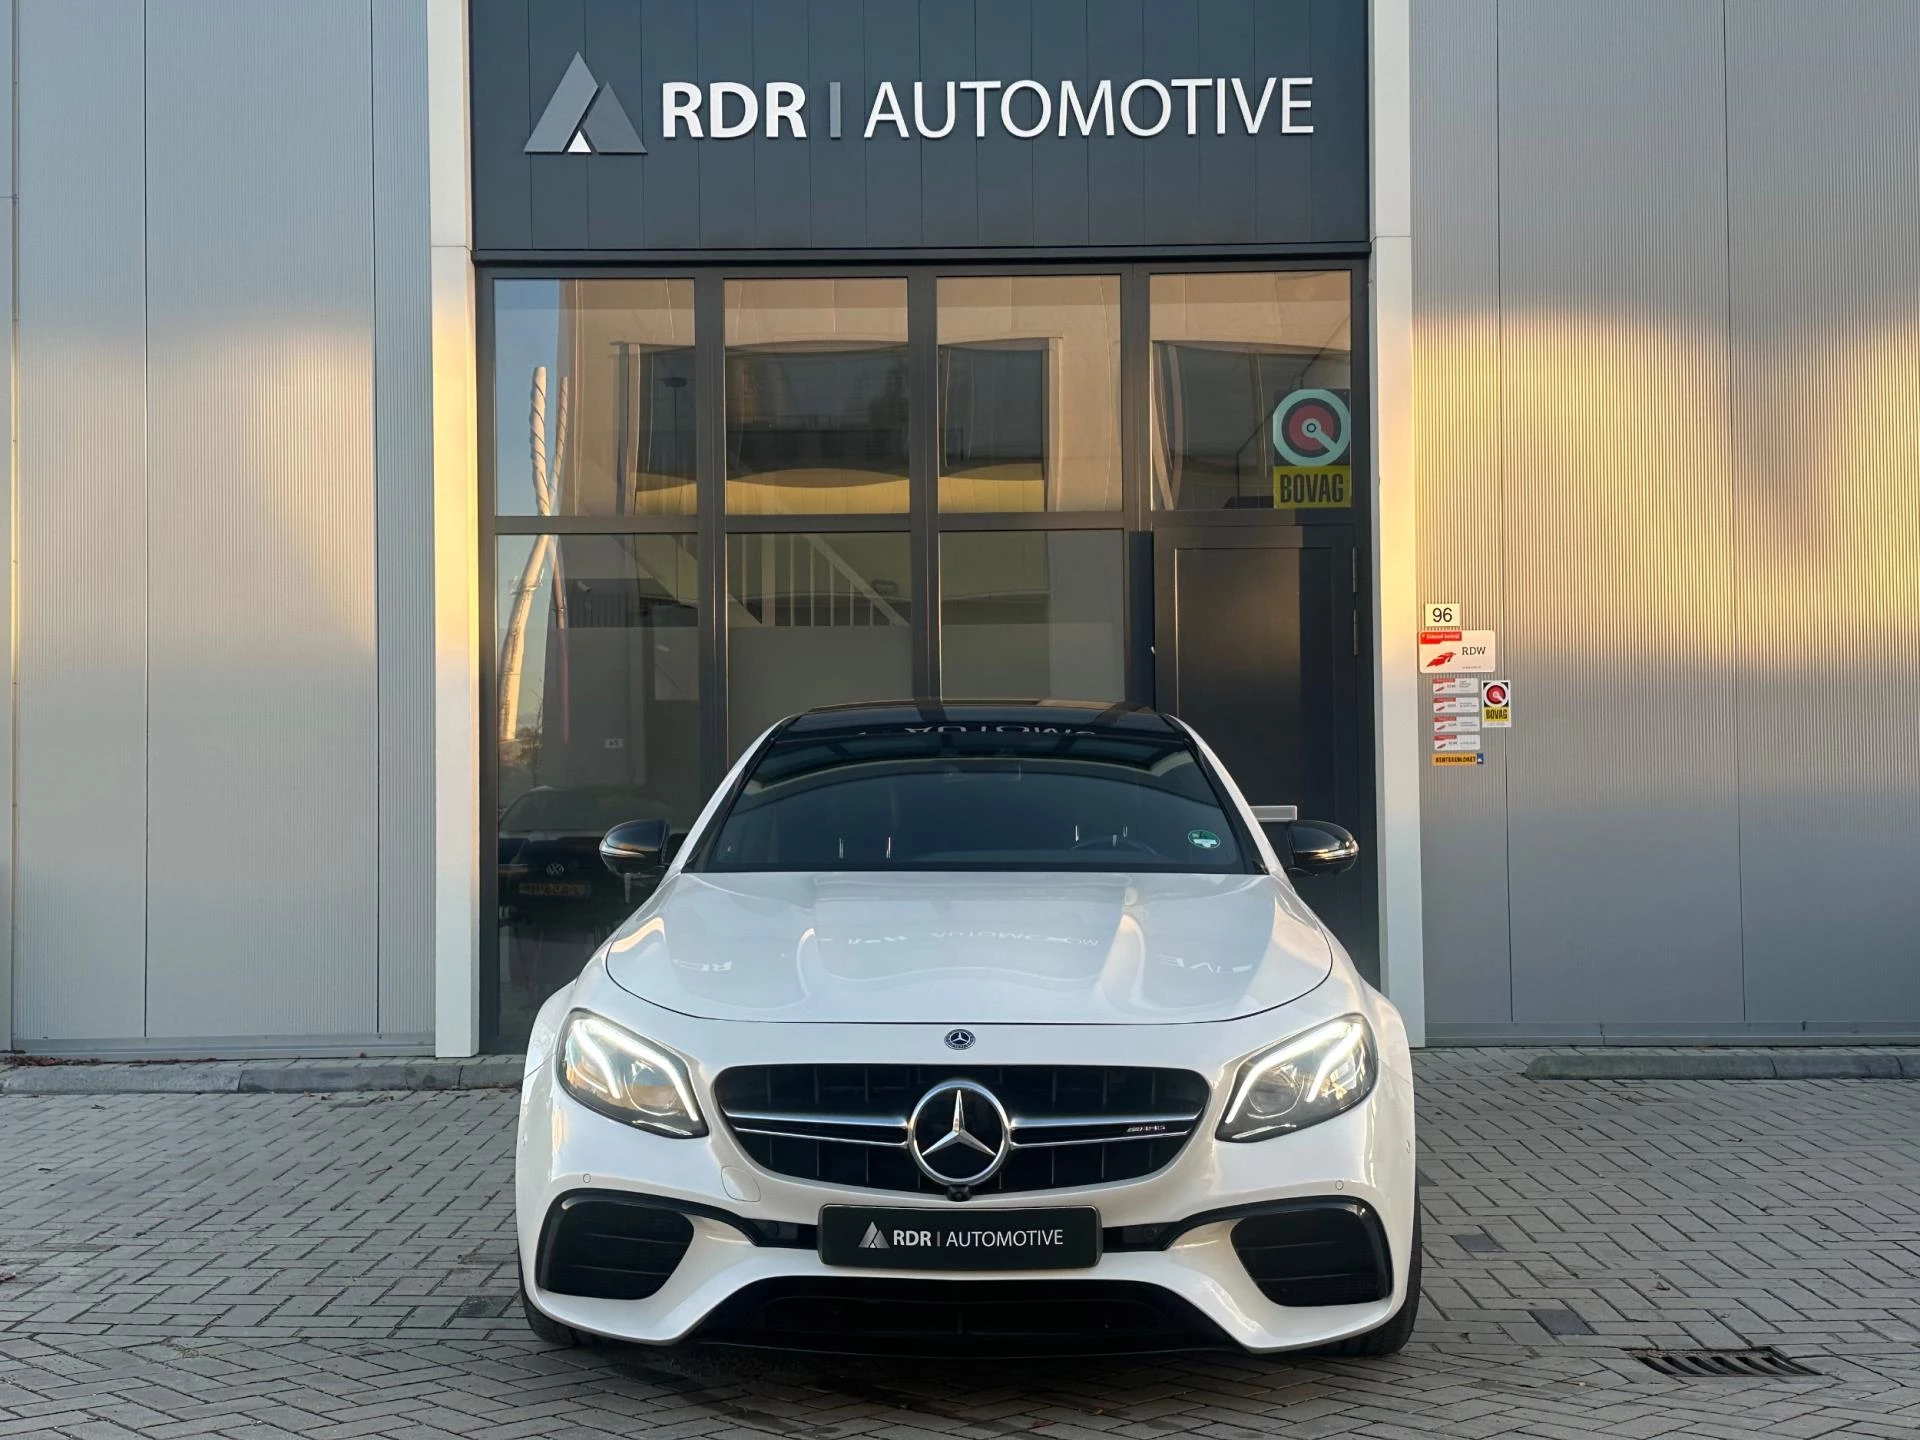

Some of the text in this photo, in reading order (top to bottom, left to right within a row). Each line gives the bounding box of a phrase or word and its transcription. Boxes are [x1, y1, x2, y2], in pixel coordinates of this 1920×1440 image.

[662, 77, 1314, 138] RDR AUTOMOTIVE
[1280, 474, 1344, 503] BOVAG
[1432, 607, 1453, 623] 96
[1461, 646, 1486, 656] RDW
[1485, 709, 1508, 720] BOVAG
[893, 1229, 1063, 1247] RDR AUTOMOTIVE
